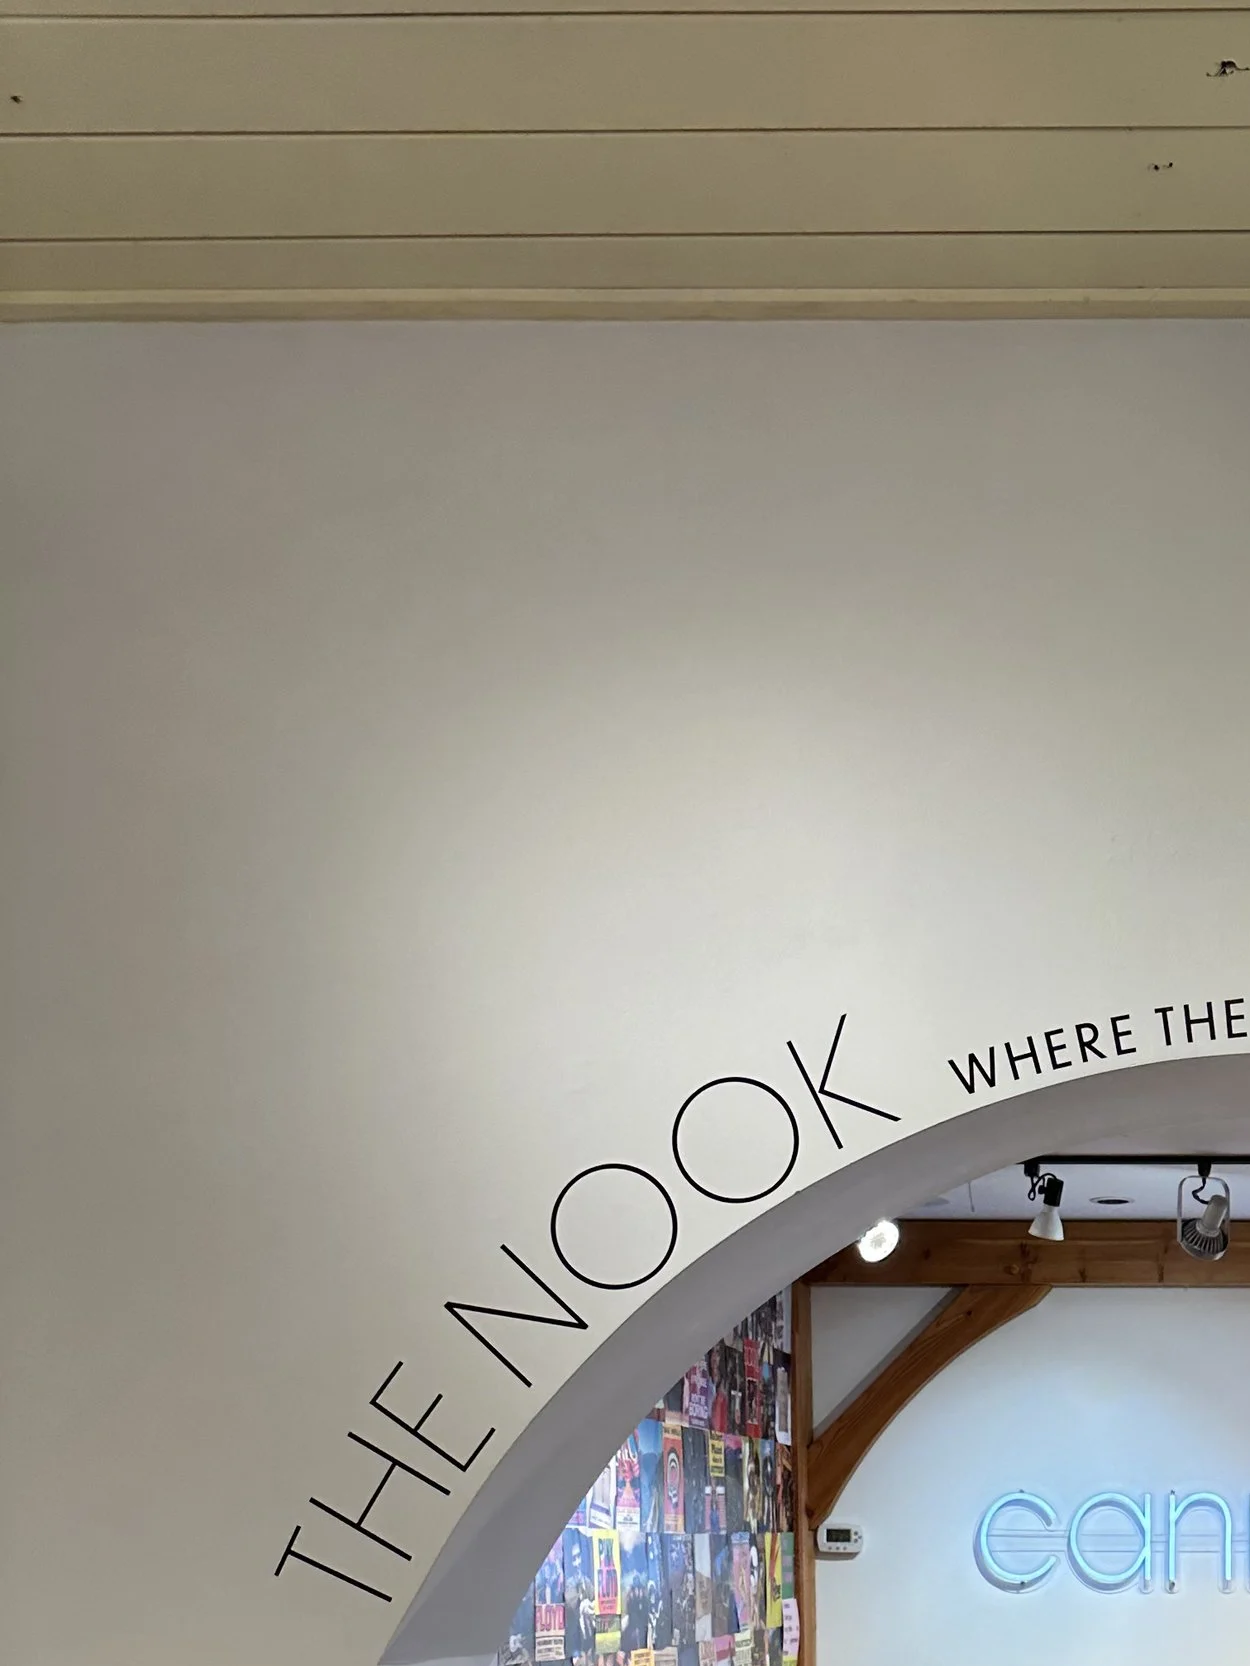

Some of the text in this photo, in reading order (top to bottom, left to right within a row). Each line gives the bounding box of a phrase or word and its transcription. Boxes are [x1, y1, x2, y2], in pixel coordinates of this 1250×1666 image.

[948, 1015, 1136, 1095] WHERE
[1155, 998, 1248, 1046] THE
[274, 1014, 901, 1602] THE NOOK
